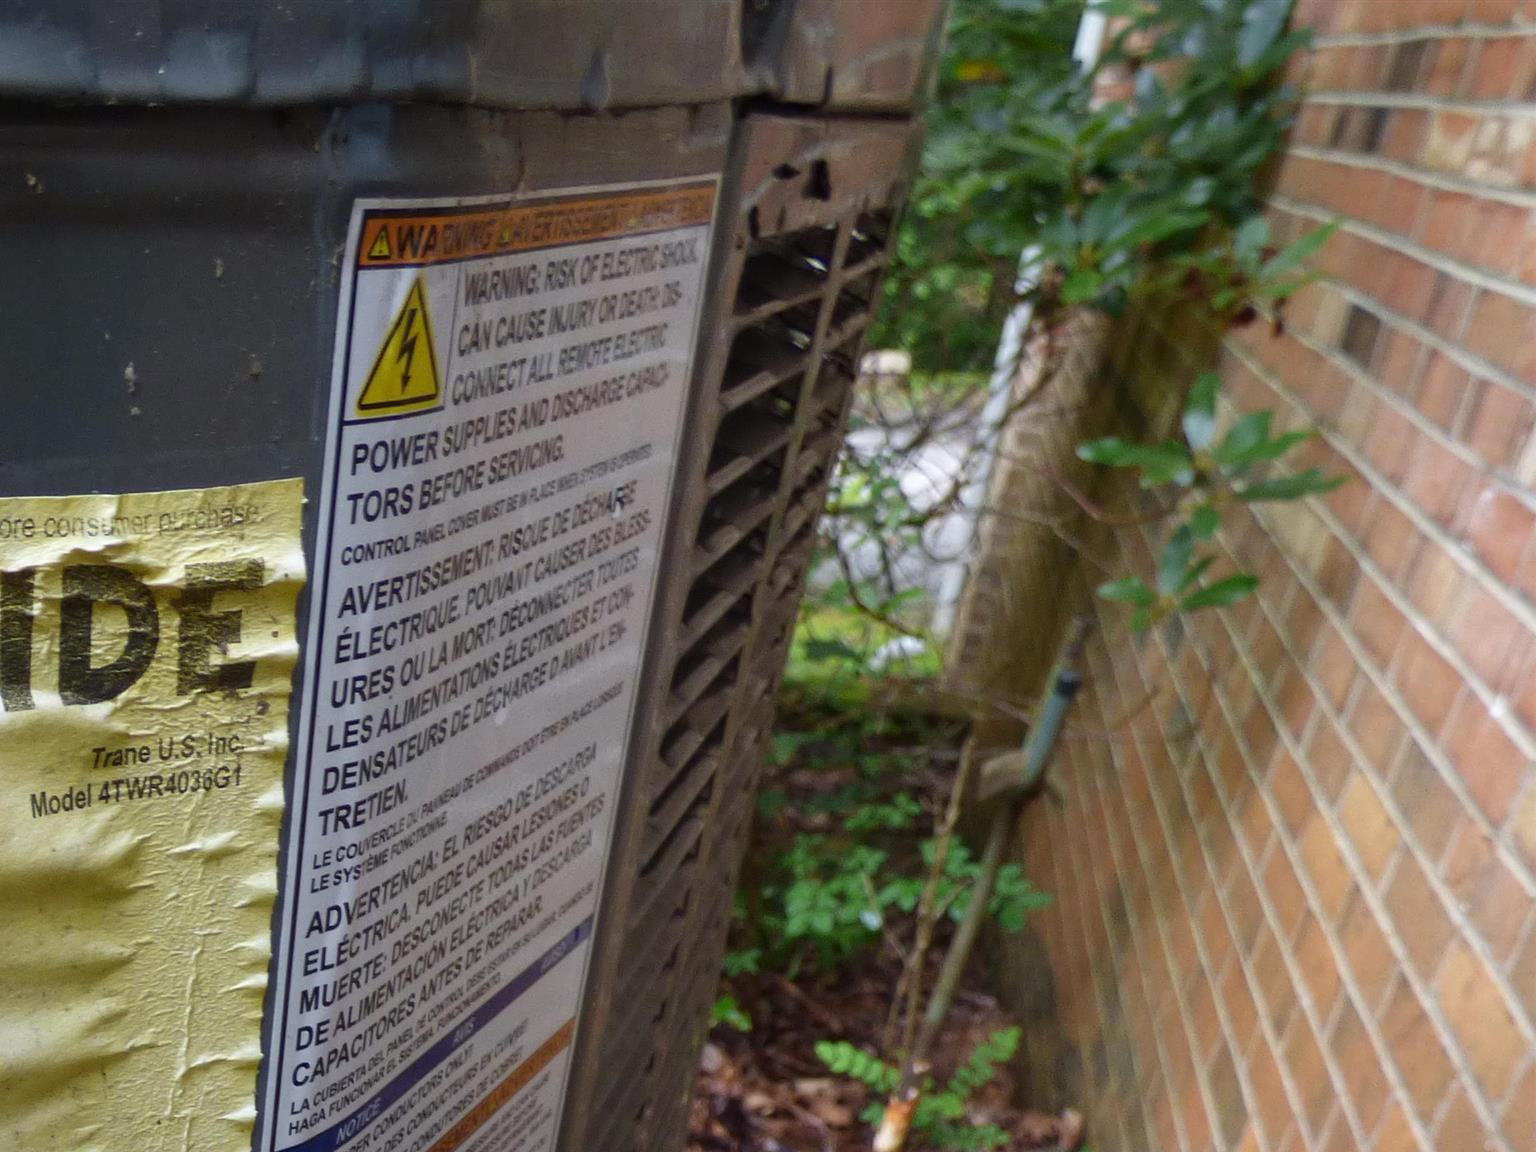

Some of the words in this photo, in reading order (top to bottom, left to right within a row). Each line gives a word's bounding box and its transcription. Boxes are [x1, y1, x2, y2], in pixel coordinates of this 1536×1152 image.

[465, 264, 541, 307] WARNING:
[544, 259, 578, 291] RISK
[580, 254, 600, 285] OF
[458, 320, 493, 357] CAN
[495, 309, 547, 348] CAUSE
[548, 299, 598, 336] INJURY
[452, 358, 526, 405] CONNECT
[527, 352, 553, 383] ALL
[558, 337, 612, 376] REMOTE
[351, 431, 439, 476] POWER
[442, 406, 515, 458] SUPPLIES
[516, 401, 548, 438] AND
[348, 482, 414, 526] TORS
[419, 459, 485, 511] BEFORE
[44, 513, 153, 537] consumer
[341, 536, 411, 566] CONTROL
[414, 525, 446, 548] PANEL
[338, 540, 494, 618] AVERTISSEMENT:
[498, 515, 550, 562] RISQUE
[465, 562, 533, 616] POUVANT
[326, 710, 374, 752] LES
[376, 651, 500, 739] ALIMENTATIONS
[330, 665, 395, 709] URES
[400, 654, 424, 687] OU
[427, 650, 448, 674] LA
[92, 745, 151, 768] Trane
[158, 734, 201, 761] U.S.
[208, 732, 244, 755] Inc.
[321, 718, 447, 795] DENSATEURS
[450, 707, 471, 738] DE
[30, 785, 92, 819] Model
[98, 763, 242, 804] 4TWR4036G1
[318, 778, 409, 837] TRETIEN.
[306, 850, 439, 939] ADVERTENCIA:
[442, 834, 459, 863] EL
[462, 798, 513, 854] RIESGO
[417, 862, 464, 909] PUEDE
[467, 828, 520, 878] CAUSAR
[299, 954, 387, 1015] MUERTE:
[391, 882, 485, 967] DESCONECTE
[292, 993, 416, 1087] CAPACITORES
[418, 956, 463, 1010] ANTES
[295, 1020, 330, 1052] DE
[333, 932, 446, 1036] ALIMENTACIÓN
[290, 1098, 311, 1116] LA
[312, 1066, 368, 1106] CUBIERTA
[288, 1111, 326, 1137] HAGA
